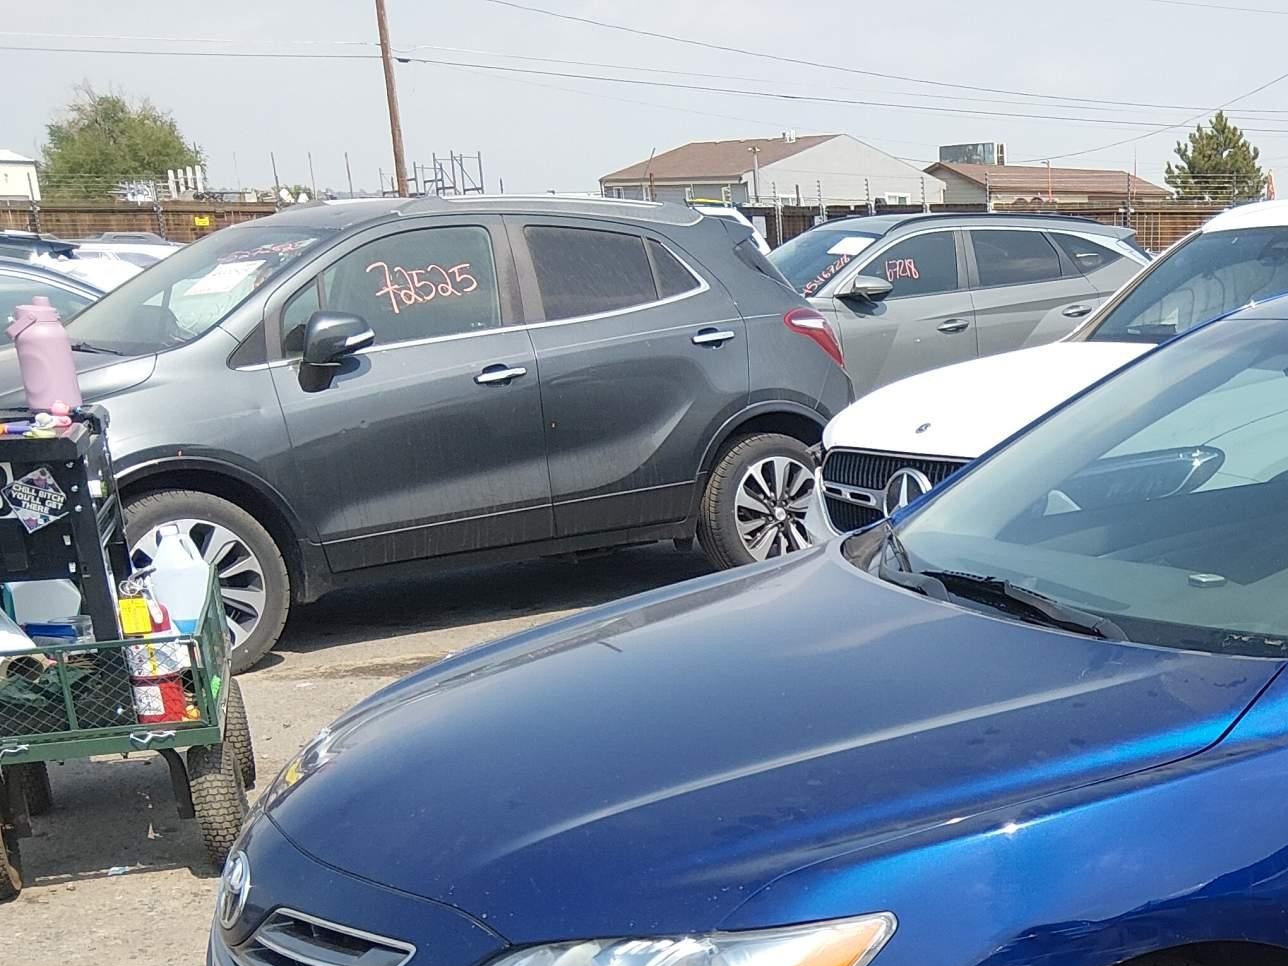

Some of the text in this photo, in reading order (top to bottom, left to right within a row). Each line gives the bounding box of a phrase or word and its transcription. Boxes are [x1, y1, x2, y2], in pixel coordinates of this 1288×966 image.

[885, 258, 920, 282] 67218
[366, 261, 478, 314] 72525
[11, 489, 64, 510] YOU'LL GET
[12, 483, 65, 503] CHILL BITCH
[21, 501, 50, 514] THERE
